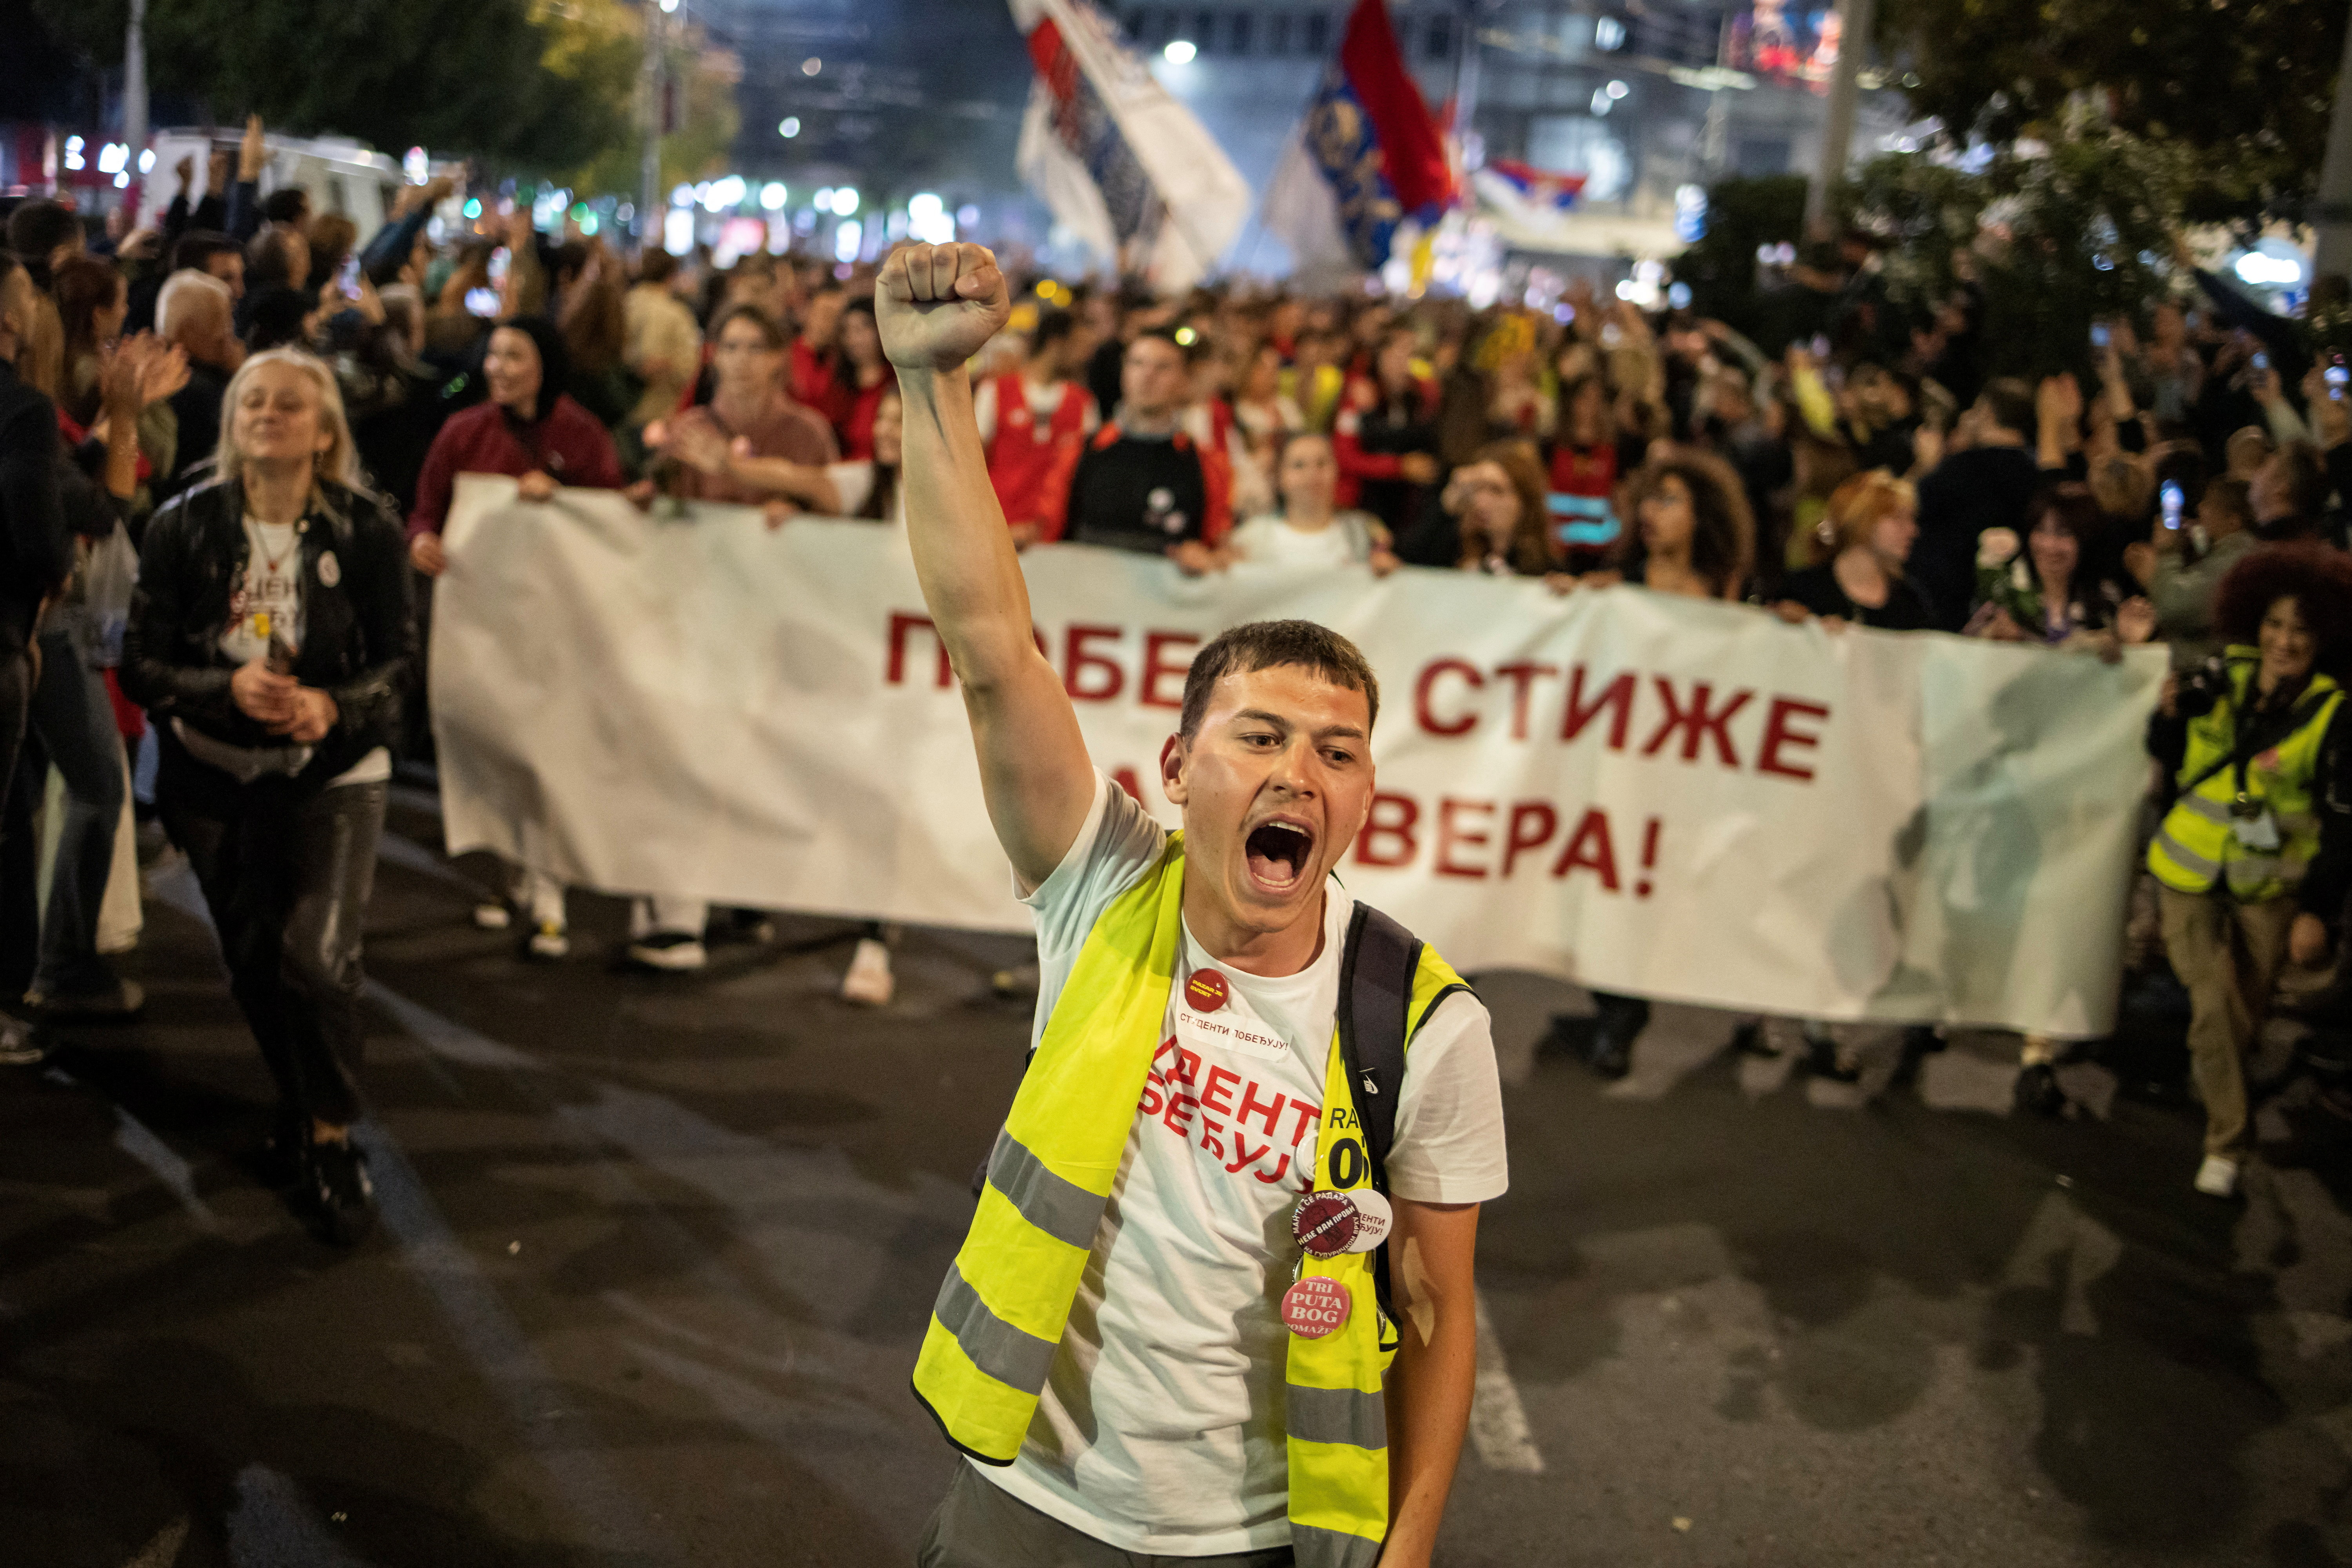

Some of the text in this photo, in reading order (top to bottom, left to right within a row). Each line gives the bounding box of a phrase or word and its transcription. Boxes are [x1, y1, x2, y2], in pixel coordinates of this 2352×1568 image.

[1414, 657, 1830, 781] СТИЖЕ
[1352, 791, 1662, 898] ВЕРА!
[1192, 980, 1215, 993] PAZAR
[1315, 1192, 1348, 1205] РАДАРА
[1298, 1205, 1356, 1245] НЕЋЕ ВАМ ПРОЋИ
[1306, 1281, 1334, 1293] TRI
[1290, 1292, 1342, 1309] PUTA
[1290, 1306, 1338, 1323] BOG
